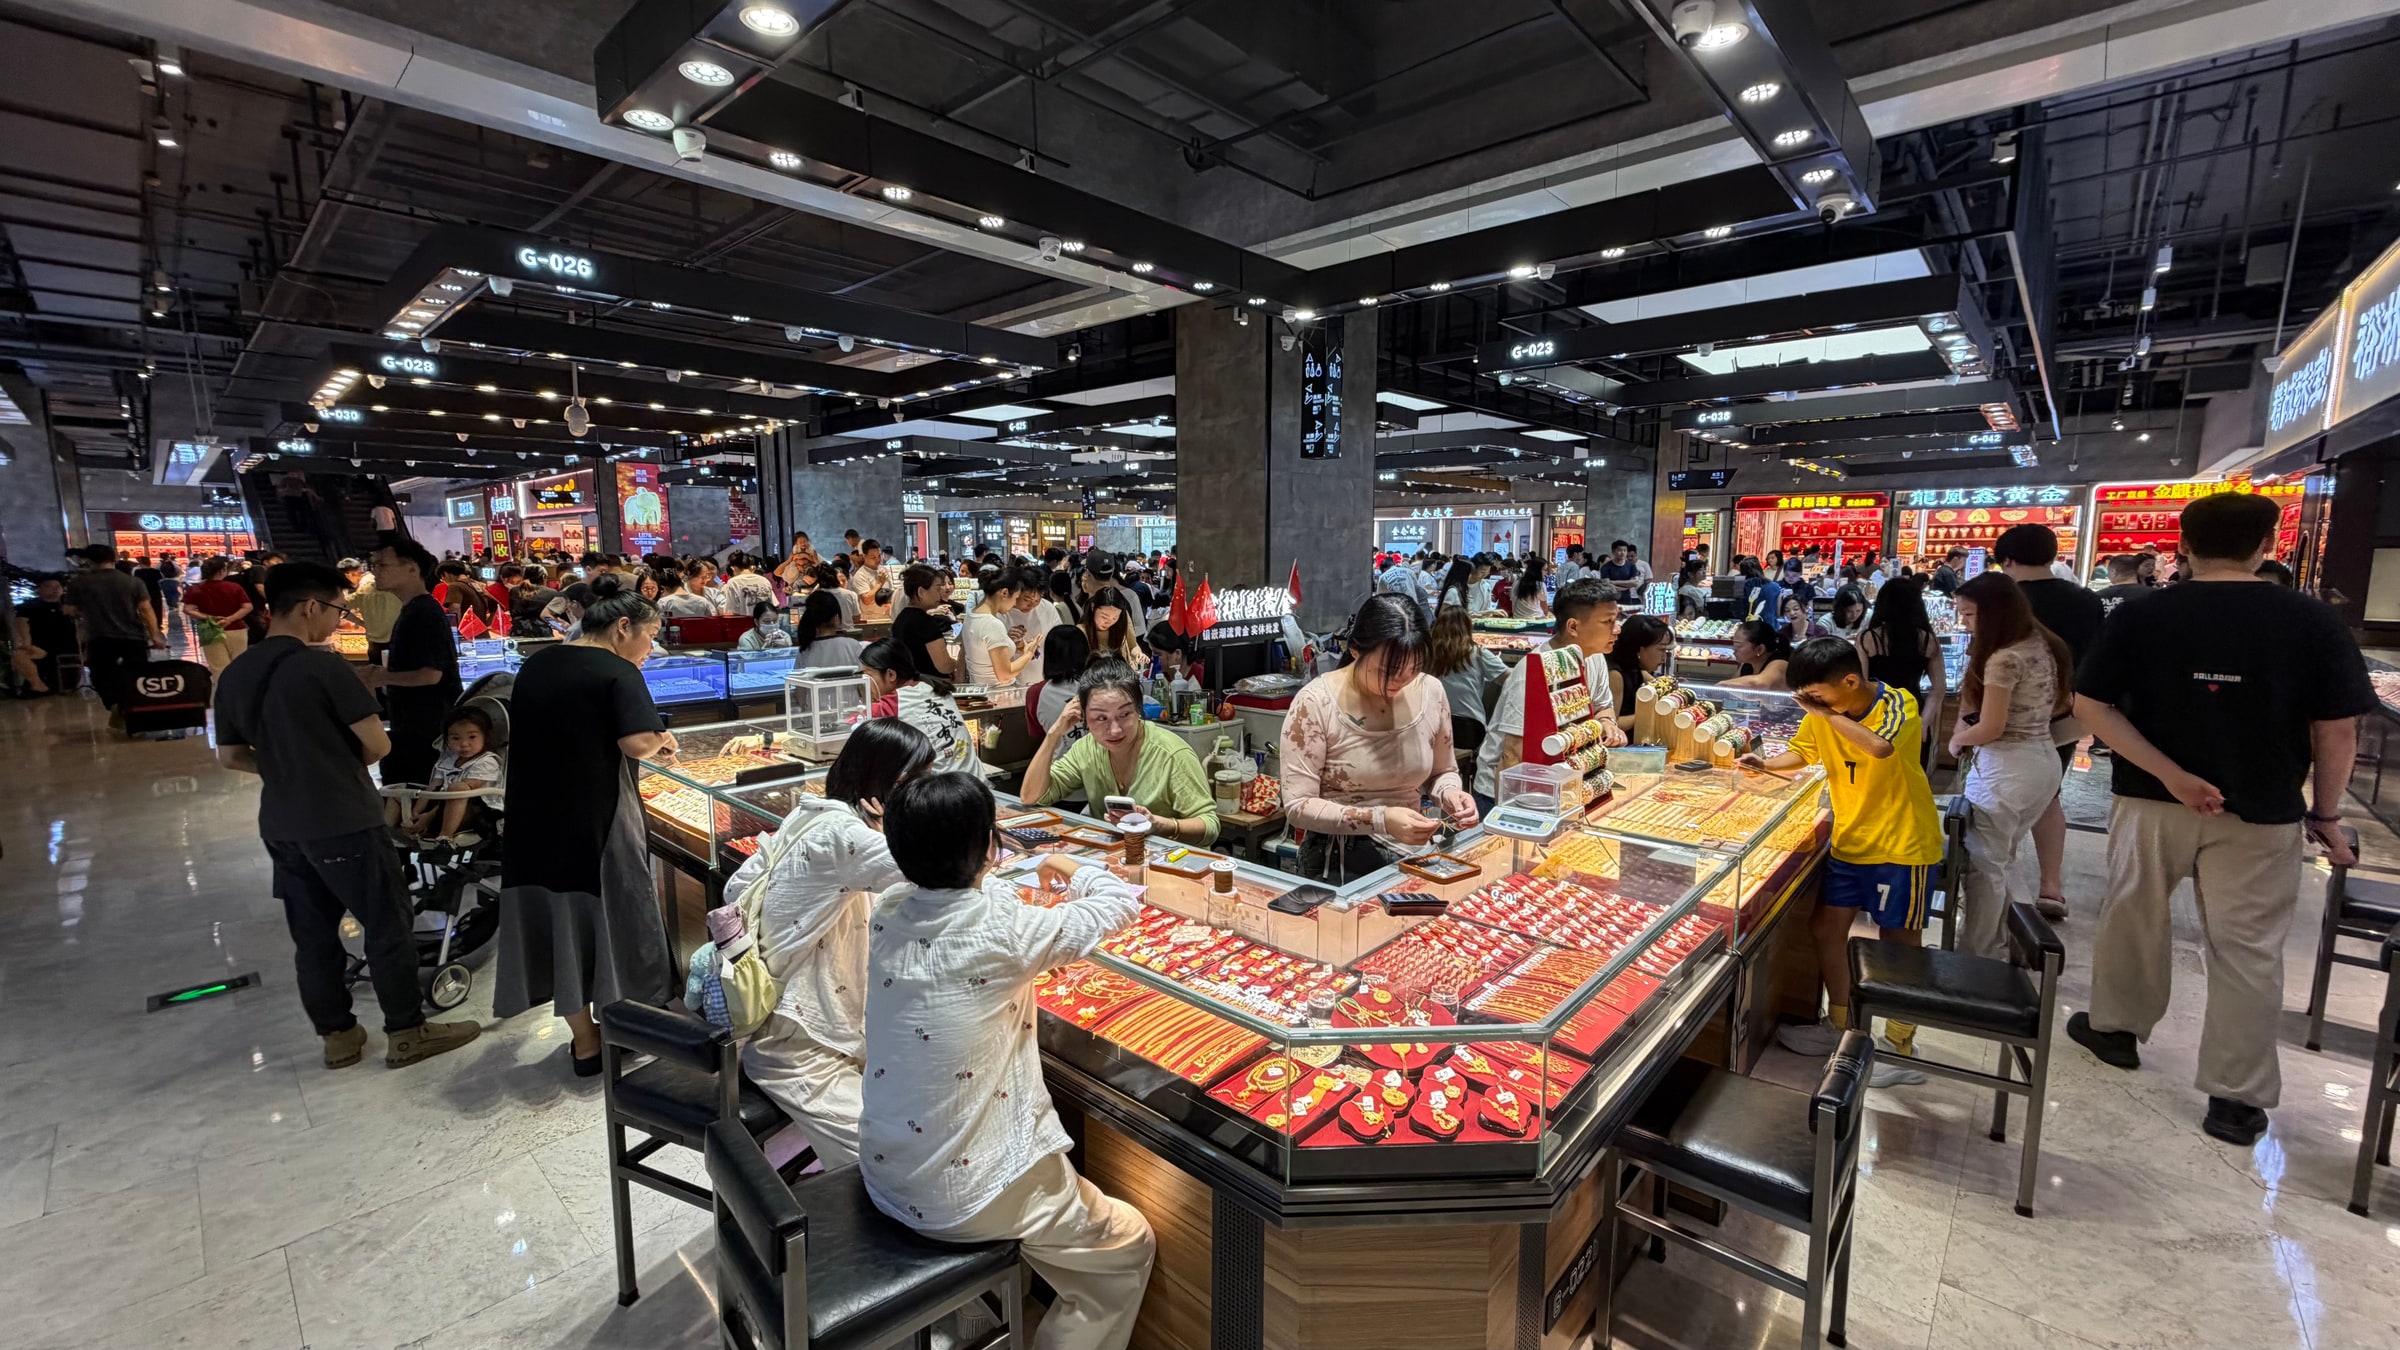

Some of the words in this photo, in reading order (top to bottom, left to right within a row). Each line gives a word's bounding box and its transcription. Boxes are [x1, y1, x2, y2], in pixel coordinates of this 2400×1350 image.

[518, 247, 594, 278] G-026
[1512, 342, 1554, 359] G-023
[382, 356, 435, 373] G-028
[319, 408, 360, 421] G-030
[1969, 434, 2002, 444] G-042
[493, 529, 509, 558] 回收
[1844, 760, 1857, 784] 7
[1877, 884, 1891, 912] 7
